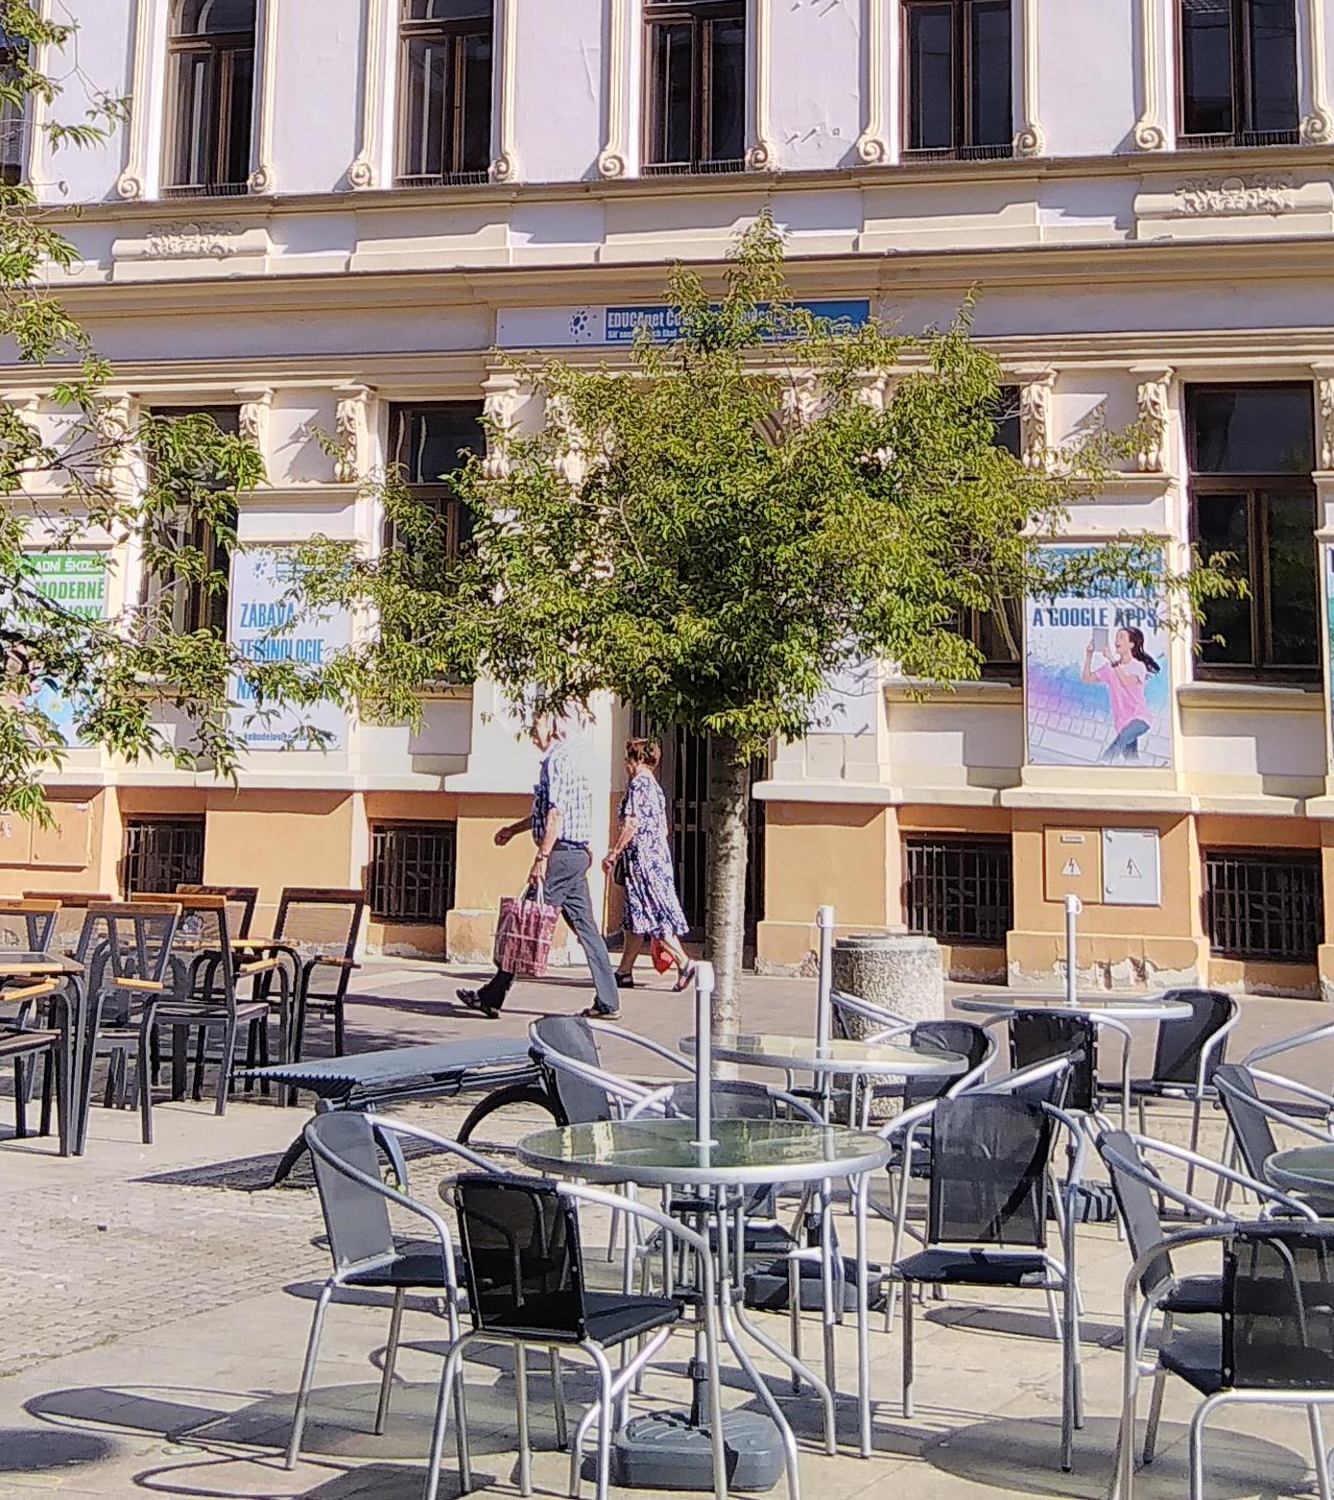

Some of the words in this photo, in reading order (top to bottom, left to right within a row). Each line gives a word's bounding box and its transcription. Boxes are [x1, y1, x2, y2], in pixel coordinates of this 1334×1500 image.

[1032, 608, 1044, 627] A
[1049, 607, 1108, 627] GOOGLE
[1113, 608, 1157, 628] APPS
